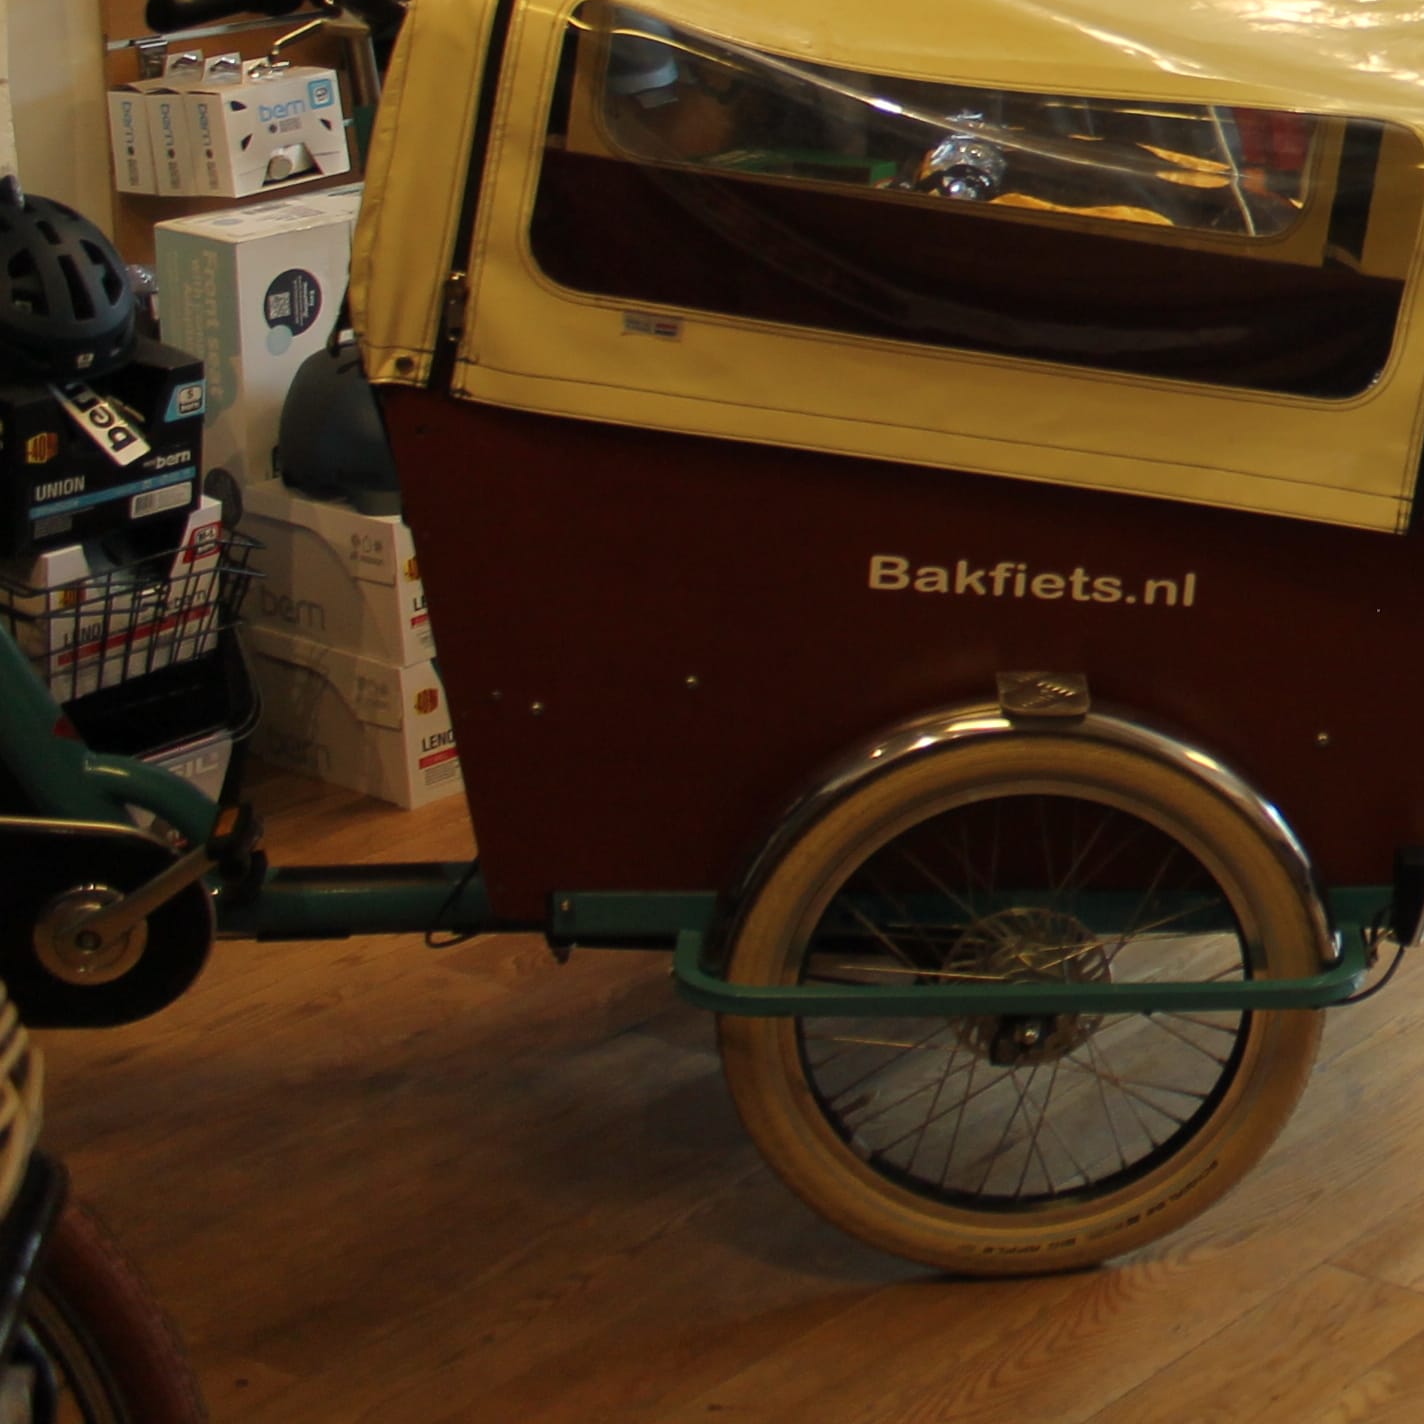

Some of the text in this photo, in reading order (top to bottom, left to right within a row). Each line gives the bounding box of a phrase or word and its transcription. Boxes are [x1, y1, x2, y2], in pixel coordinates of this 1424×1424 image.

[122, 101, 134, 145] bern
[160, 103, 174, 147] bern
[197, 103, 212, 147] bern
[259, 99, 306, 122] bern
[203, 250, 219, 329] Front
[157, 450, 192, 470] bern
[35, 475, 85, 502] UNION
[868, 552, 1197, 609] Bakfiets.nl
[260, 585, 327, 640] bern
